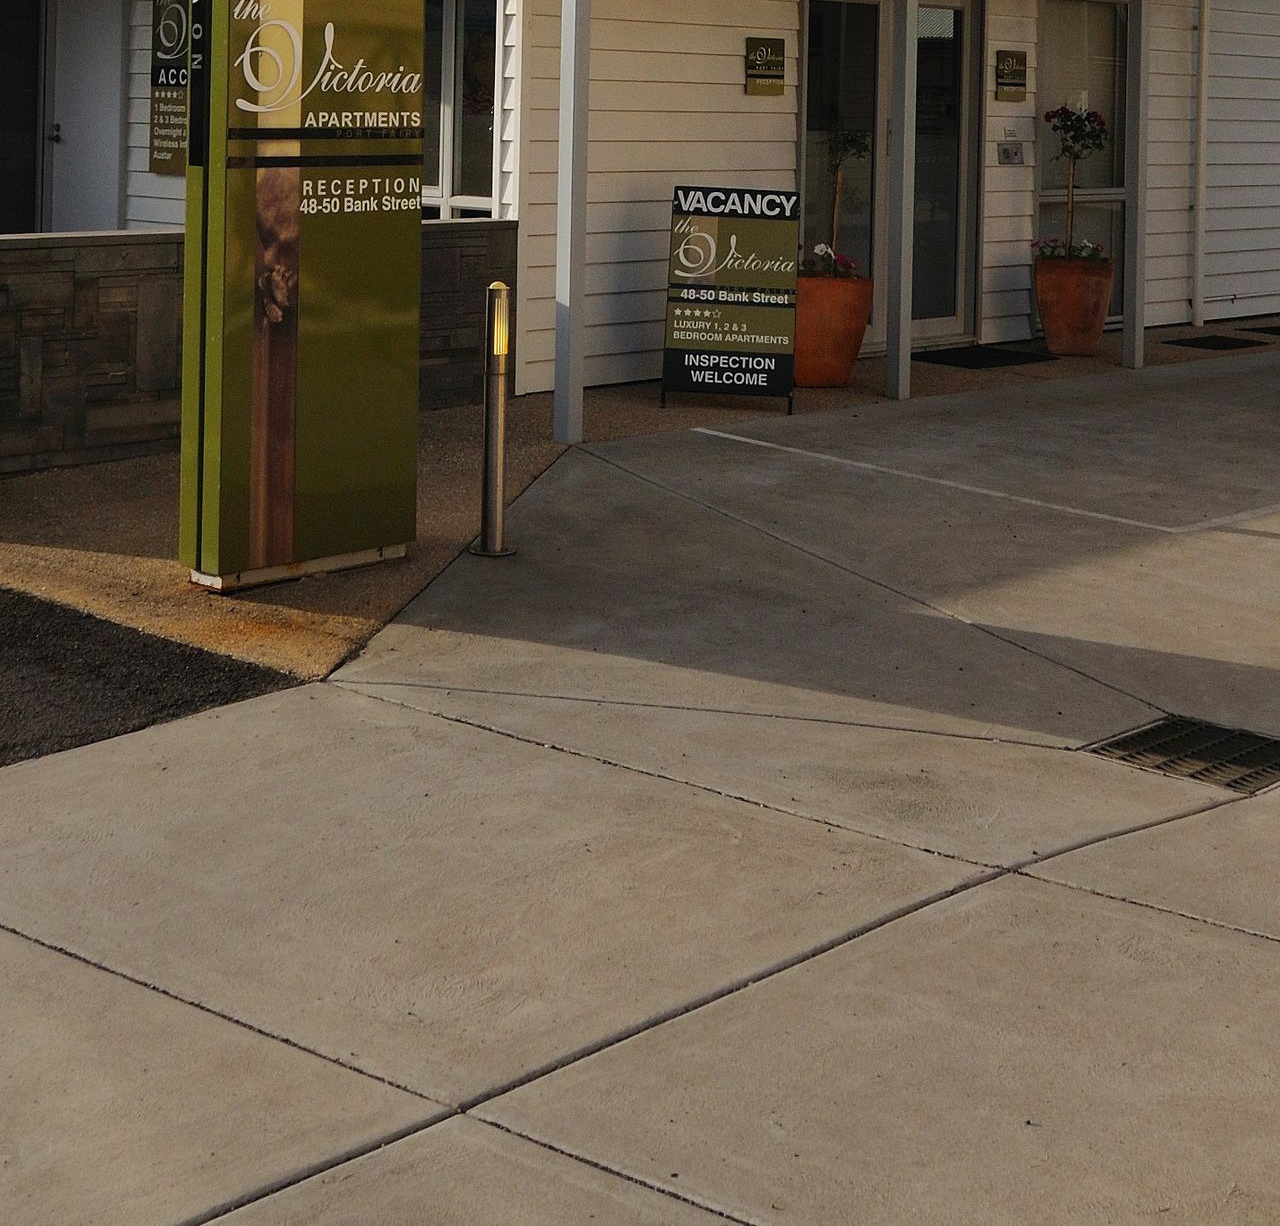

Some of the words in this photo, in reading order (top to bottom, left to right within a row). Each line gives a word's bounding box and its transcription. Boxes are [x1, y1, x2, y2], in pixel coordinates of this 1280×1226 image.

[191, 22, 203, 69] NO
[233, 19, 422, 112] Victoria
[304, 111, 421, 128] APARTMENTS
[302, 177, 420, 196] RECEPTION
[299, 197, 340, 214] 48-50
[344, 196, 378, 212] Bank
[381, 195, 421, 211] Street
[677, 190, 797, 216] VACANCY
[674, 217, 699, 234] the
[673, 232, 795, 277] Victoria
[680, 289, 715, 301] 48-50
[718, 291, 749, 303] Bank
[752, 292, 789, 304] Street
[673, 320, 711, 330] LUXURY
[724, 322, 730, 331] 2
[732, 322, 740, 331] &
[741, 323, 747, 332] 3
[673, 331, 722, 342] BEDROOM
[724, 334, 790, 345] APARTMENTS
[684, 354, 776, 370] INSPECTION
[690, 370, 768, 386] WELCOME
